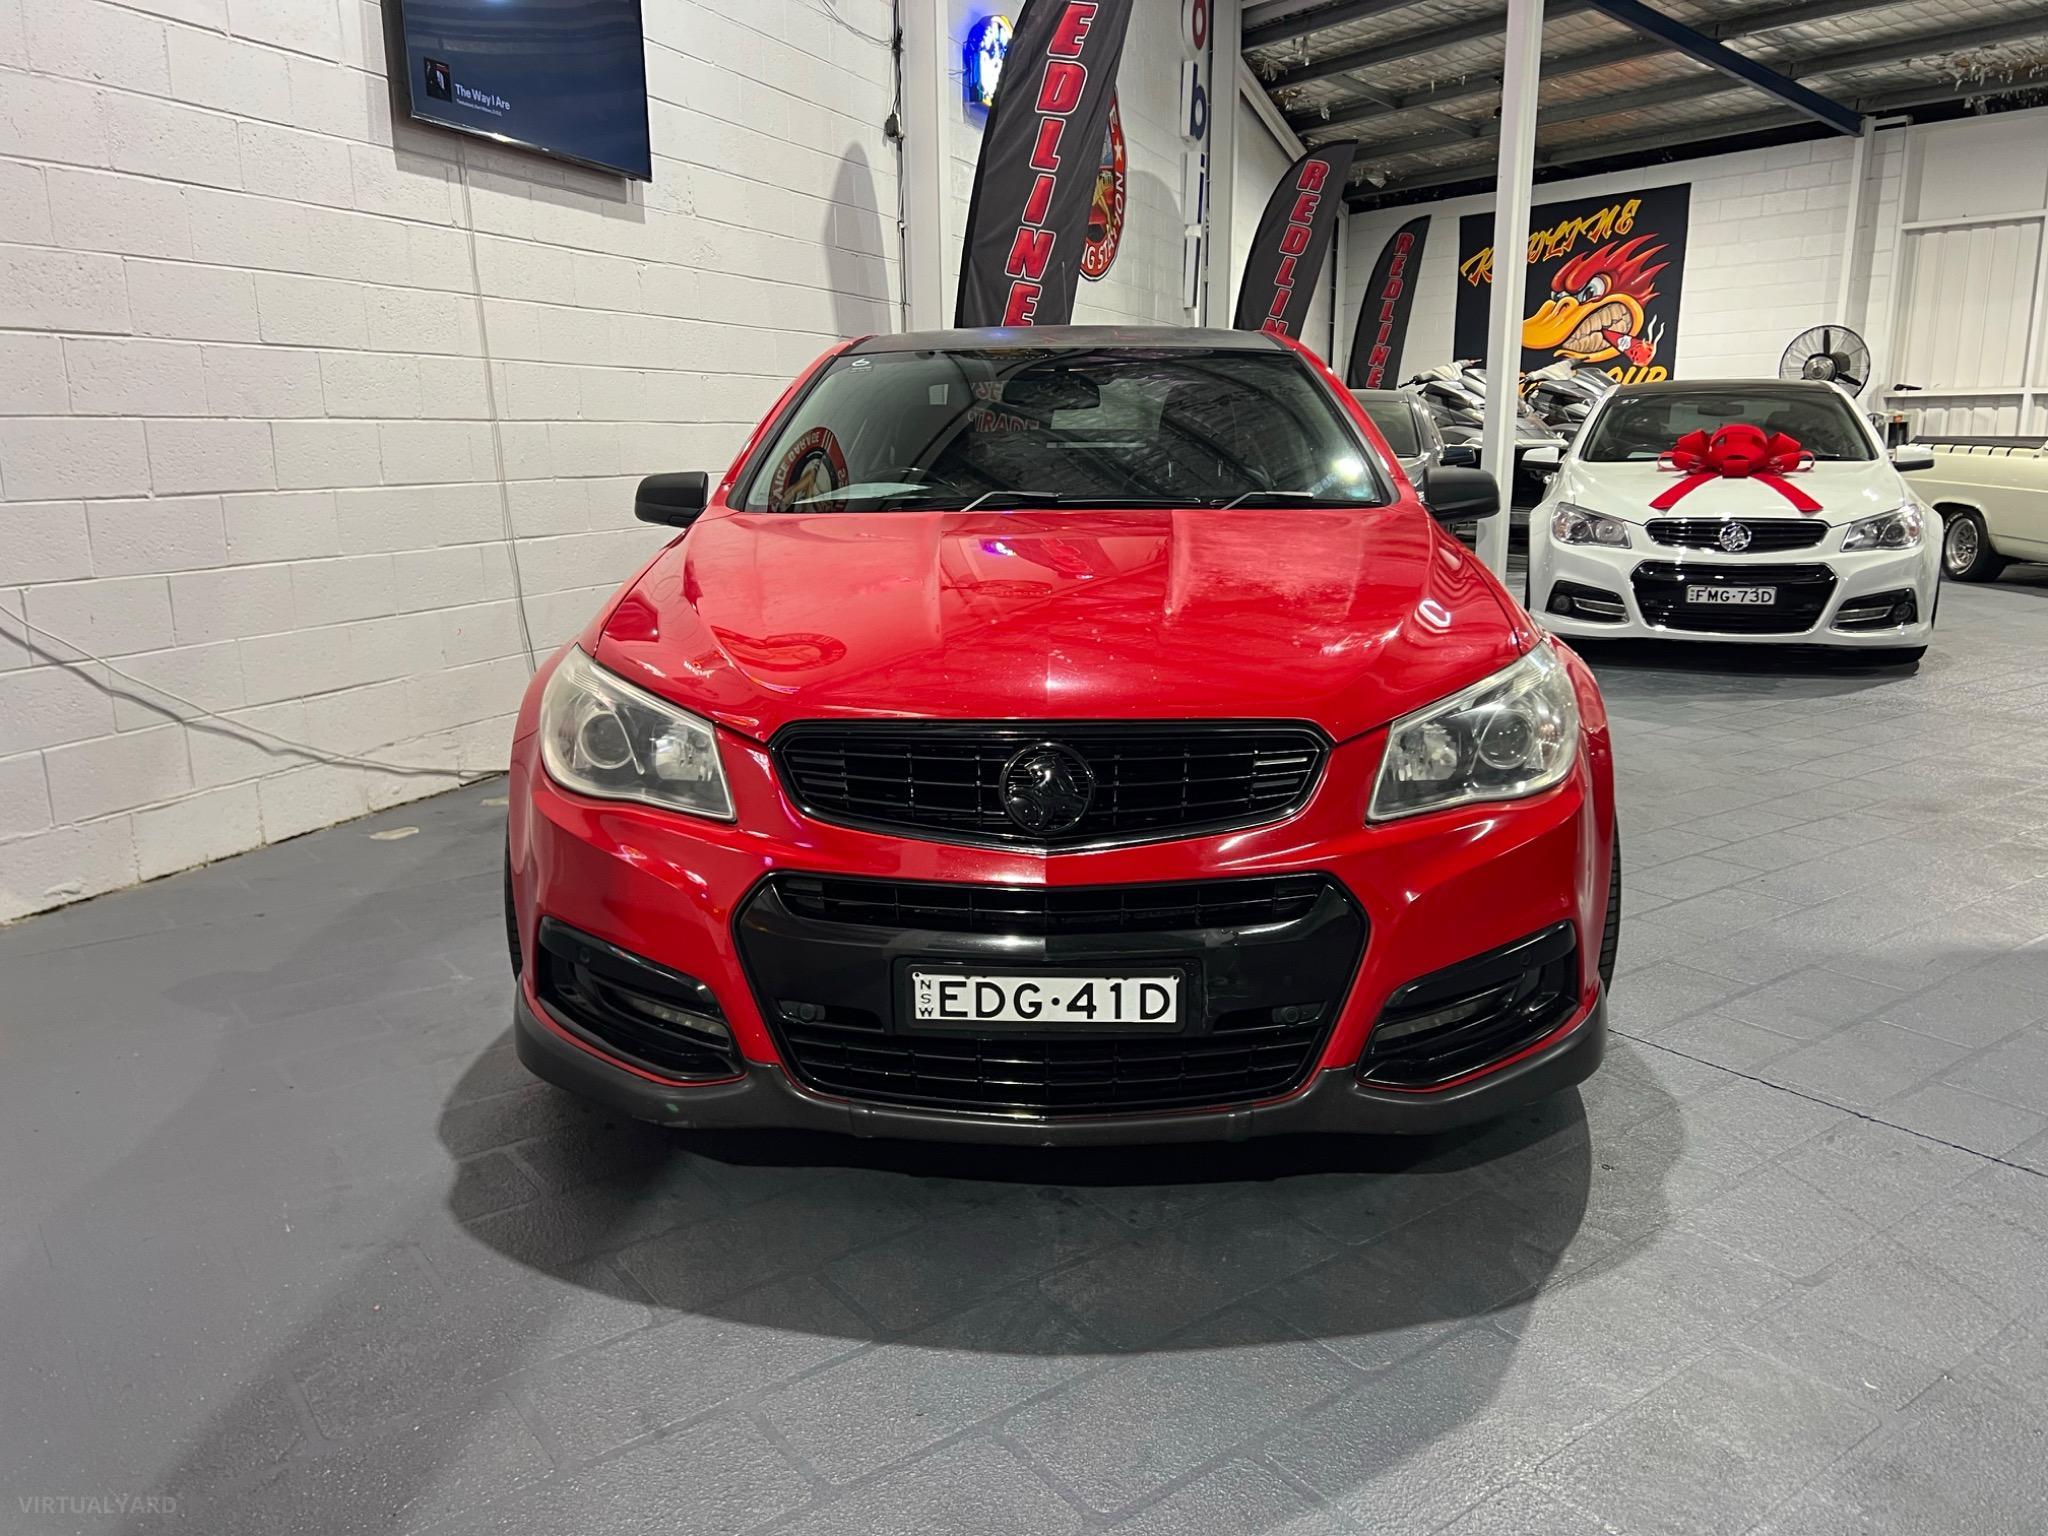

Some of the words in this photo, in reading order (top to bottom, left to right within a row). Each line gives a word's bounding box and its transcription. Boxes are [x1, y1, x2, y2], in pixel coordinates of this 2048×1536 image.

[454, 83, 471, 99] The
[471, 88, 491, 107] Way
[495, 96, 511, 110] Are
[1002, 1, 1098, 328] EDLINE
[1186, 0, 1207, 310] obil
[1262, 159, 1330, 336] REDLIN
[1366, 232, 1415, 390] REDLINE
[1460, 199, 1642, 287] RDLINE
[919, 979, 934, 1018] NSW
